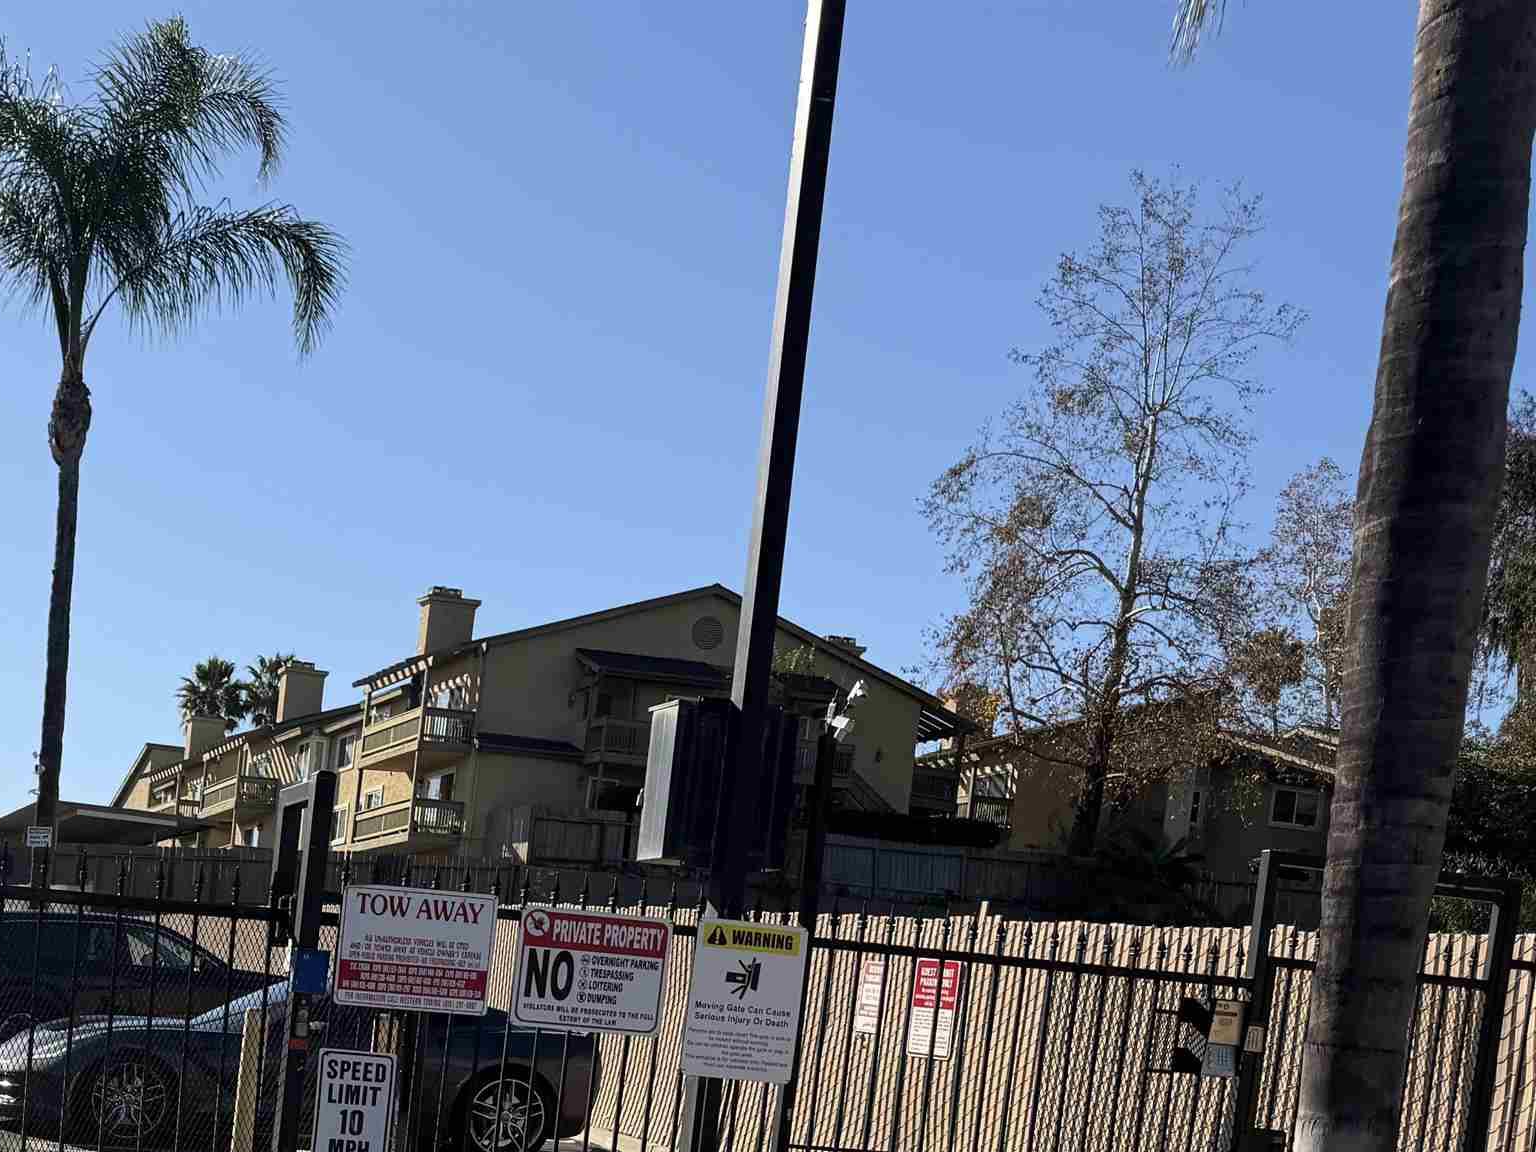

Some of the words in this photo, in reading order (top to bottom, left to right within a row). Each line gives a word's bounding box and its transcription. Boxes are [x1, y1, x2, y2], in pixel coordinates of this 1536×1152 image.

[357, 893, 412, 918] TOW
[416, 899, 484, 924] AWAY
[552, 919, 602, 944] PRIVATE
[603, 924, 664, 950] PROPERTY
[732, 930, 793, 950] WARNING
[591, 954, 630, 968] OVERNIGHT
[630, 960, 660, 971] PARKING
[524, 948, 574, 1001] NO
[590, 968, 634, 982] TRESPASSING
[588, 980, 624, 992] LOITERING
[586, 992, 617, 1005] DUMPING
[556, 1005, 570, 1014] WILL
[694, 1000, 724, 1012] Moving
[726, 1003, 745, 1013] Gate
[748, 1006, 764, 1015] Can
[766, 1008, 792, 1017] Cause
[694, 1012, 725, 1022] Serious
[727, 1014, 751, 1026] Injury
[753, 1016, 764, 1025] Or
[766, 1018, 789, 1028] Death
[326, 1058, 386, 1083] SPEED
[327, 1083, 382, 1106] LIMIT
[340, 1108, 364, 1136] 10
